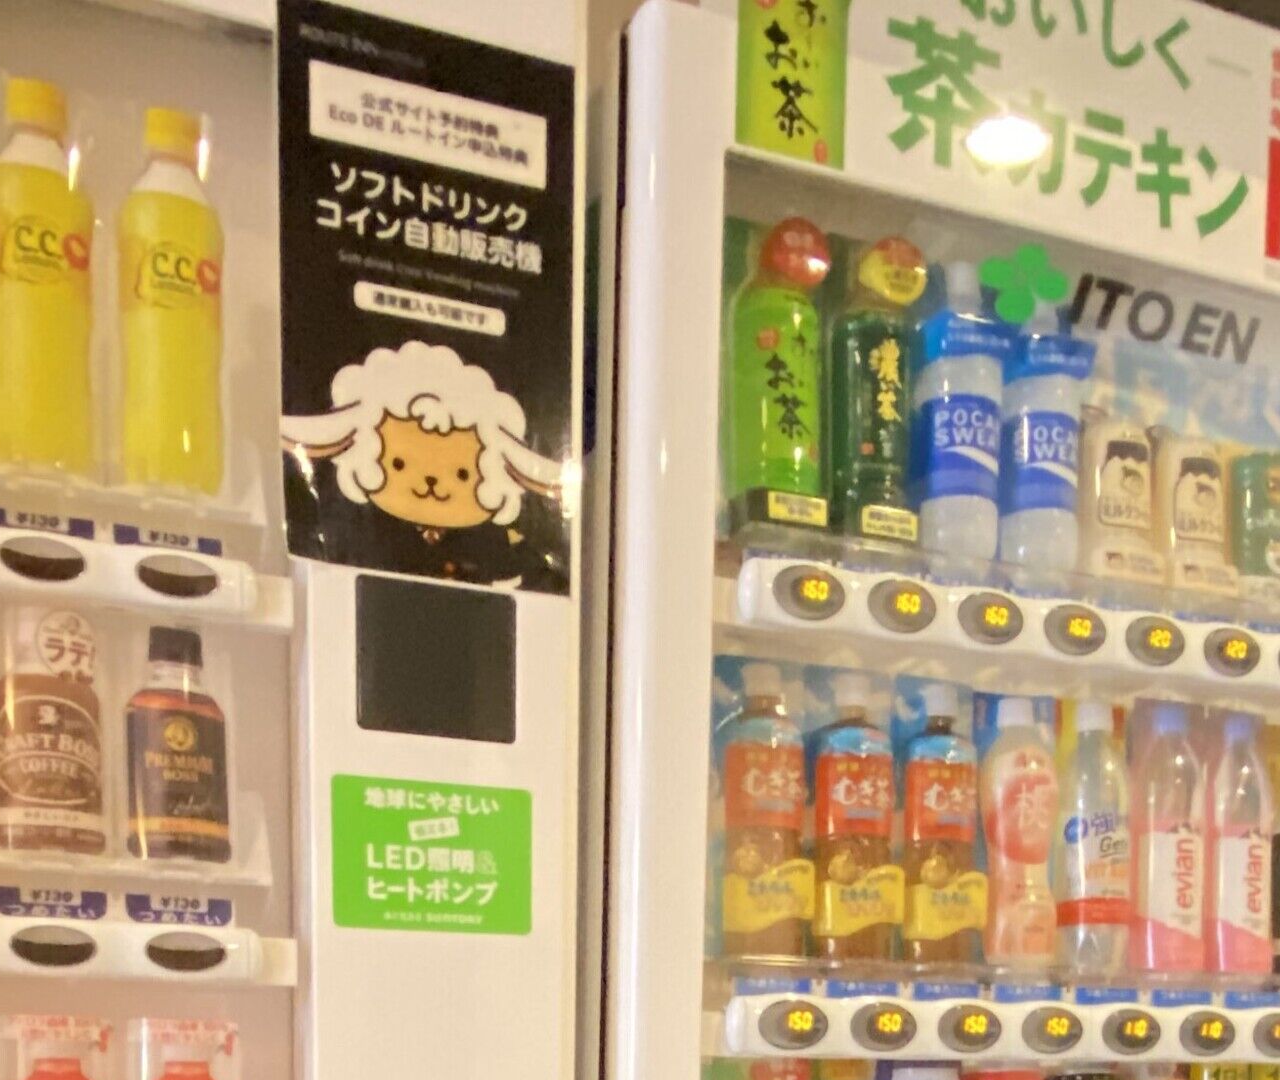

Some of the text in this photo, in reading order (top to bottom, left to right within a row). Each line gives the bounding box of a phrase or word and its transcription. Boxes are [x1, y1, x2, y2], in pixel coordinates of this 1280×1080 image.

[330, 162, 527, 232] ソフトドリンク
[316, 199, 542, 275] コイン自動販売機
[1069, 272, 1175, 343] ITO
[1180, 302, 1261, 364] EN
[802, 579, 829, 601] 160
[364, 786, 500, 815] 地球にやさしい
[1175, 836, 1195, 910] evian
[1245, 842, 1265, 914] evian
[366, 875, 499, 906] ヒートポンプ
[788, 1010, 813, 1032] 150
[878, 1012, 903, 1033] 150
[963, 1014, 988, 1035] 150
[1046, 1017, 1070, 1036] 150
[1124, 1019, 1148, 1039] 110
[1200, 1021, 1223, 1040] 110
